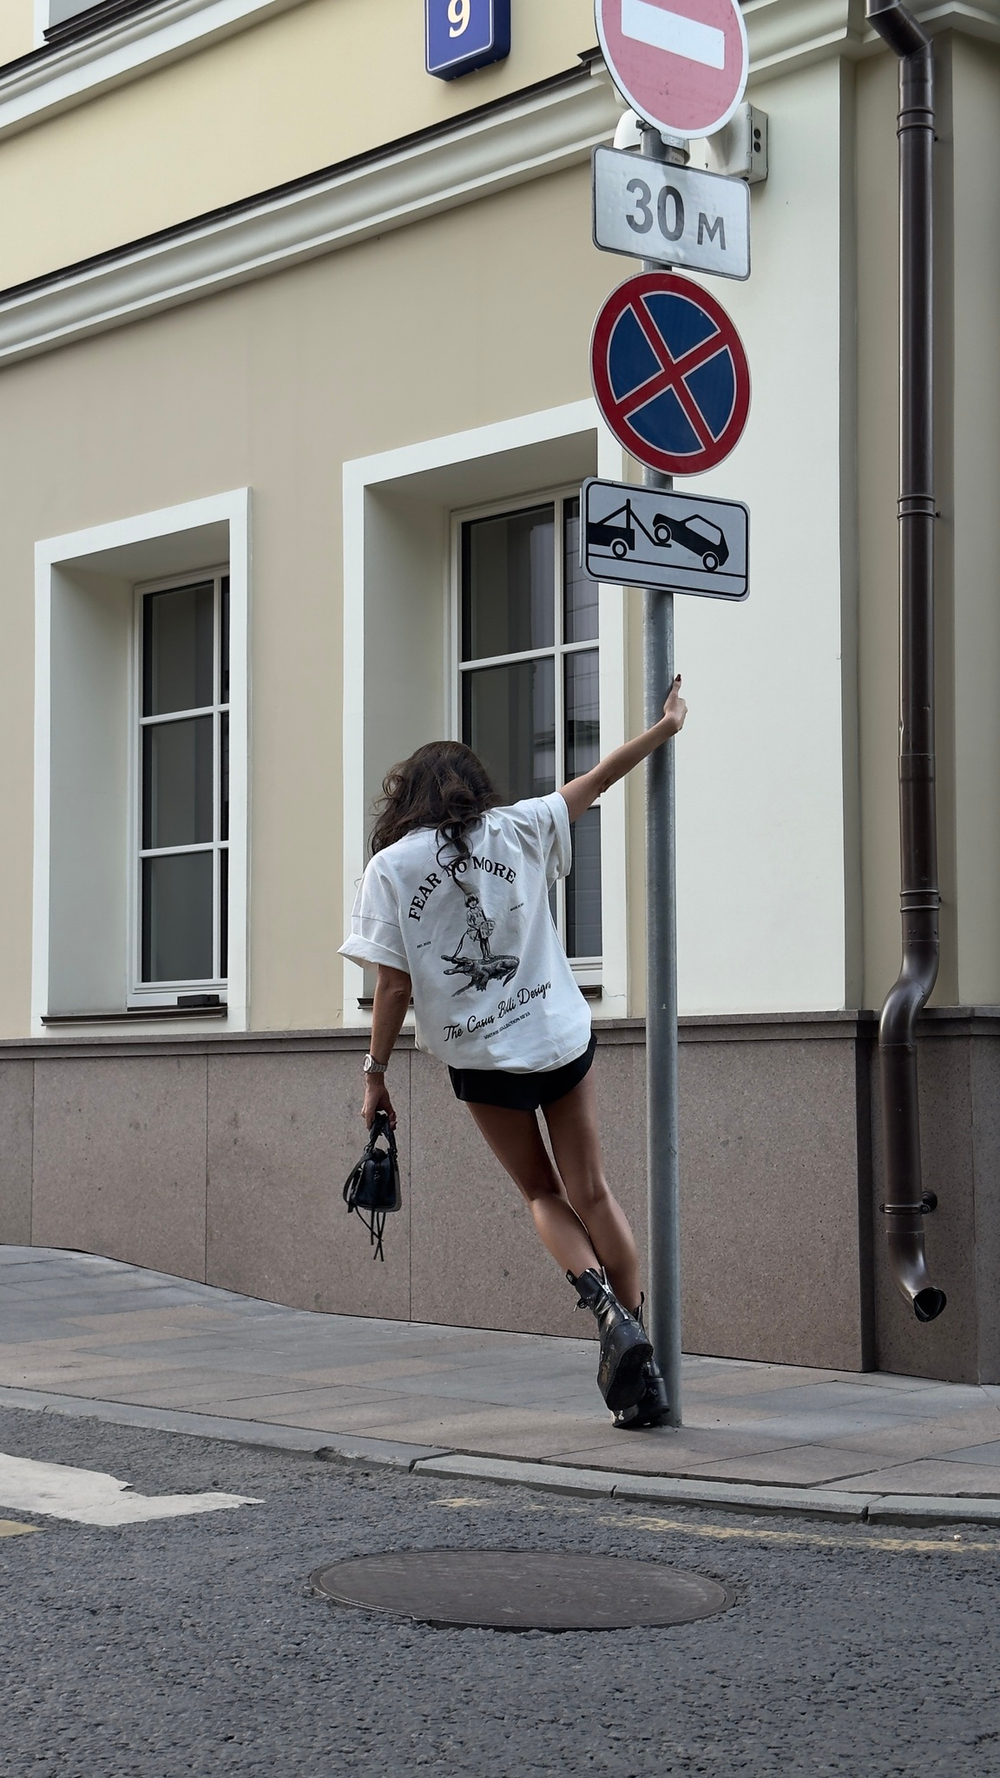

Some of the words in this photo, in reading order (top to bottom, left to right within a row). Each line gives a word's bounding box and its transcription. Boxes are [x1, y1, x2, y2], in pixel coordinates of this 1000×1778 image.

[447, 0, 470, 38] 9
[625, 178, 685, 242] 30
[408, 872, 442, 922] FEAR
[472, 856, 517, 884] MORE
[443, 1023, 463, 1042] The
[466, 1015, 496, 1033] Casus
[517, 981, 552, 1006] Design
